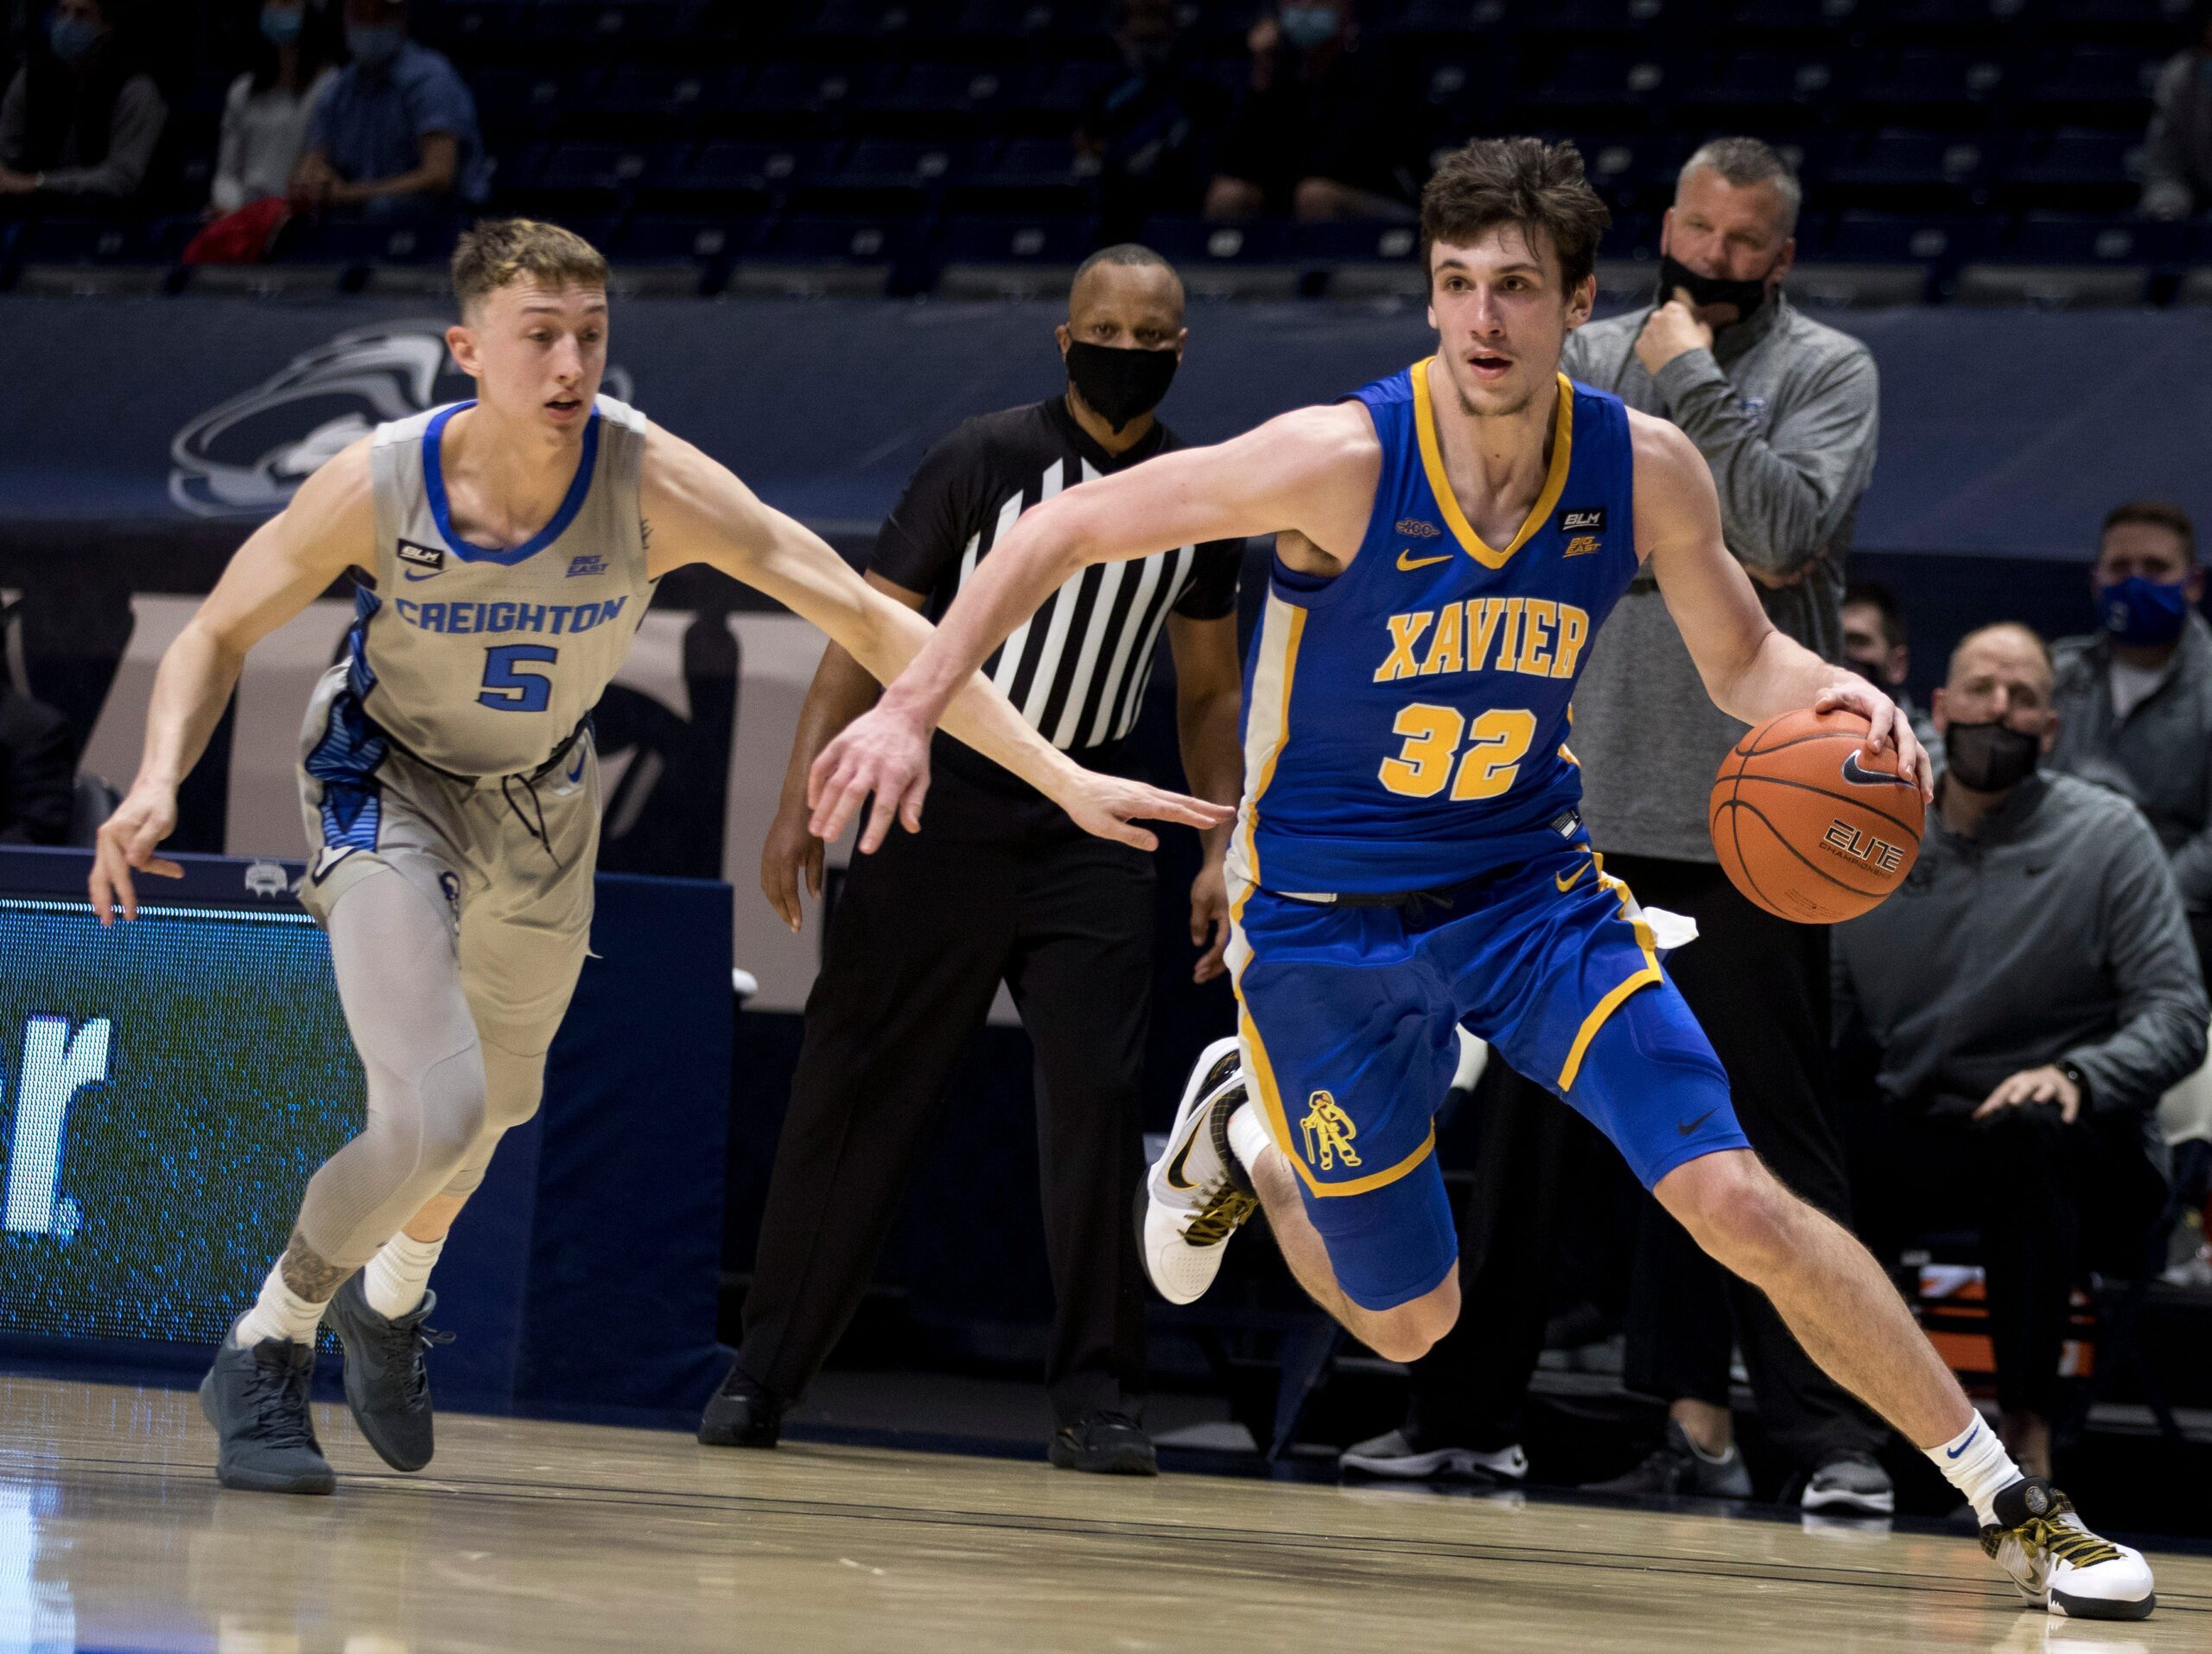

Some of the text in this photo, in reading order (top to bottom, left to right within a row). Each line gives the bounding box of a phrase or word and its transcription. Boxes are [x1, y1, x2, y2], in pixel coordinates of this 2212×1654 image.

[1564, 512, 1600, 525] BLM
[401, 545, 441, 562] BLM
[1565, 544, 1601, 554] EAST
[1570, 537, 1595, 545] BIG
[567, 563, 609, 574] EAST
[396, 595, 629, 634] CREIGHTON
[1373, 598, 1589, 683] XAVIER
[475, 644, 558, 711] 5
[1377, 703, 1537, 801] 32
[1823, 818, 1905, 873] ELITE
